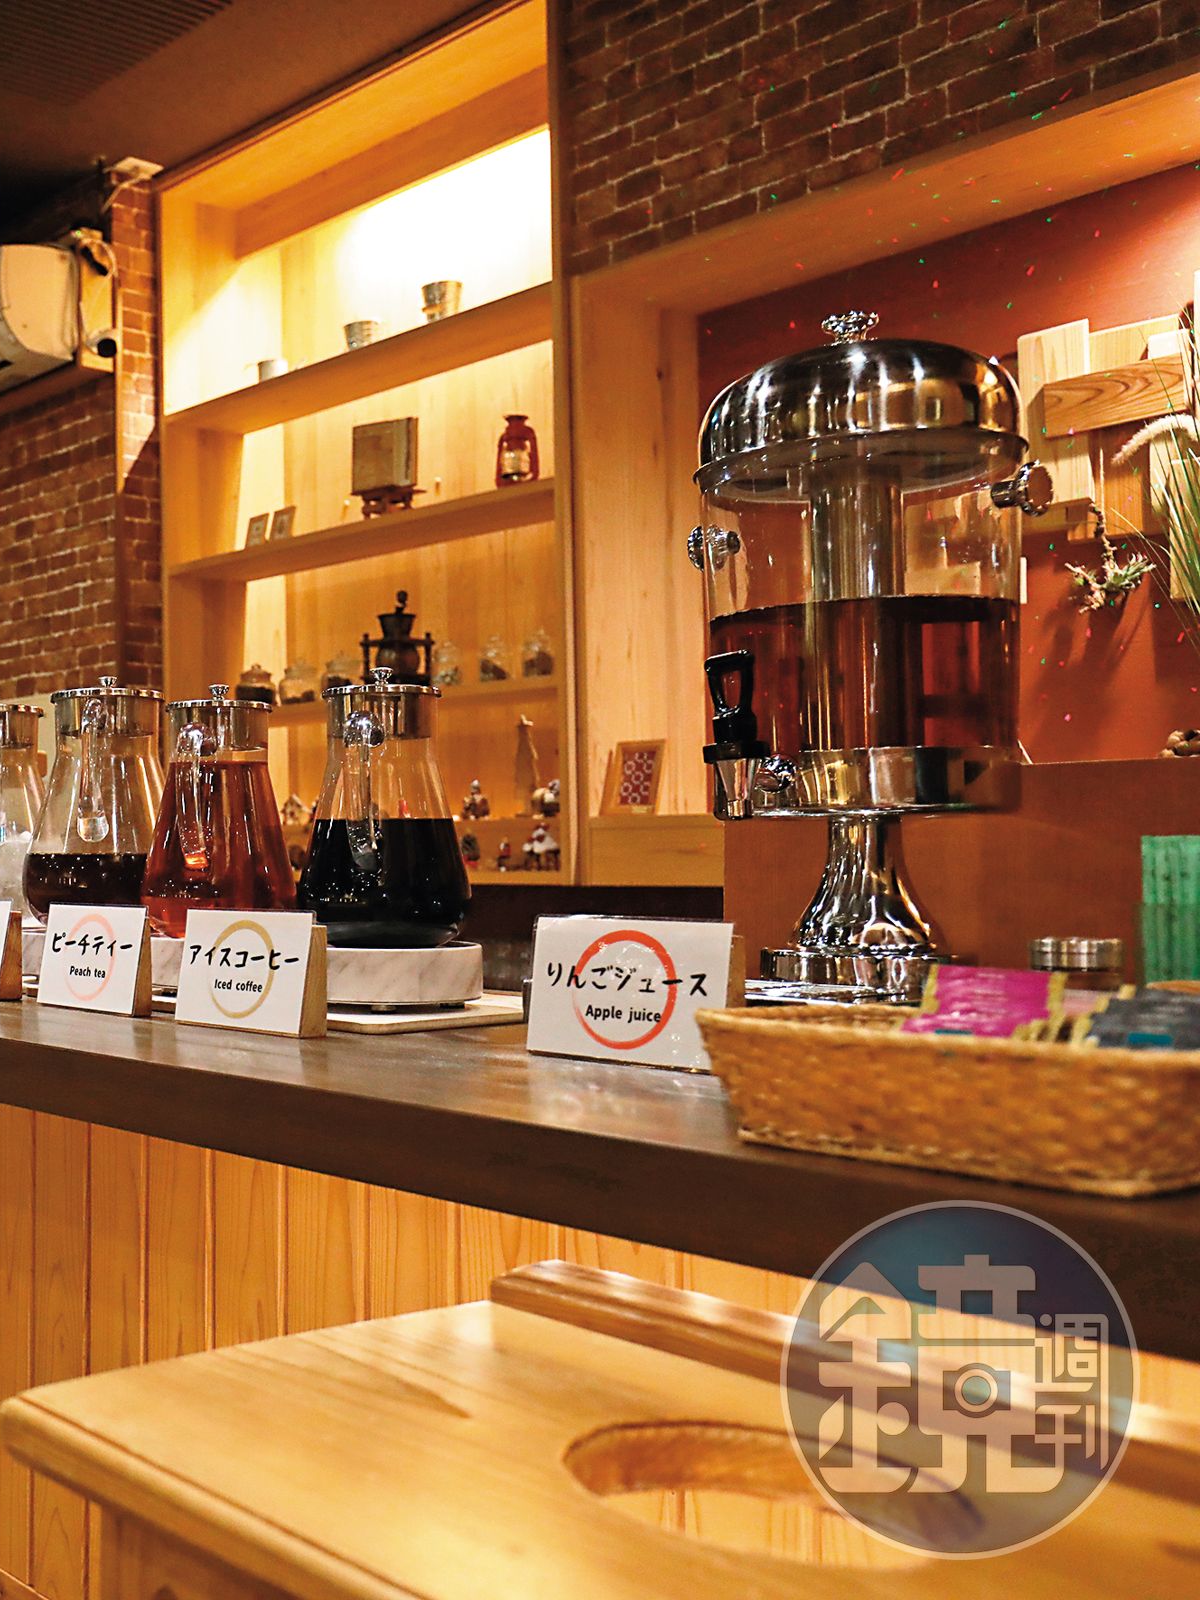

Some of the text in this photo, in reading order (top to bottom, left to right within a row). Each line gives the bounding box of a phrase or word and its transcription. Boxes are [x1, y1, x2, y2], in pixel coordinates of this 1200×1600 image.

[52, 932, 133, 957] ピーチティー
[189, 945, 300, 970] アイスコーヒー
[69, 965, 106, 979] Peach tea
[547, 962, 708, 997] りんごジュース
[214, 979, 263, 993] Iced coffee
[585, 1005, 662, 1024] Apple juice
